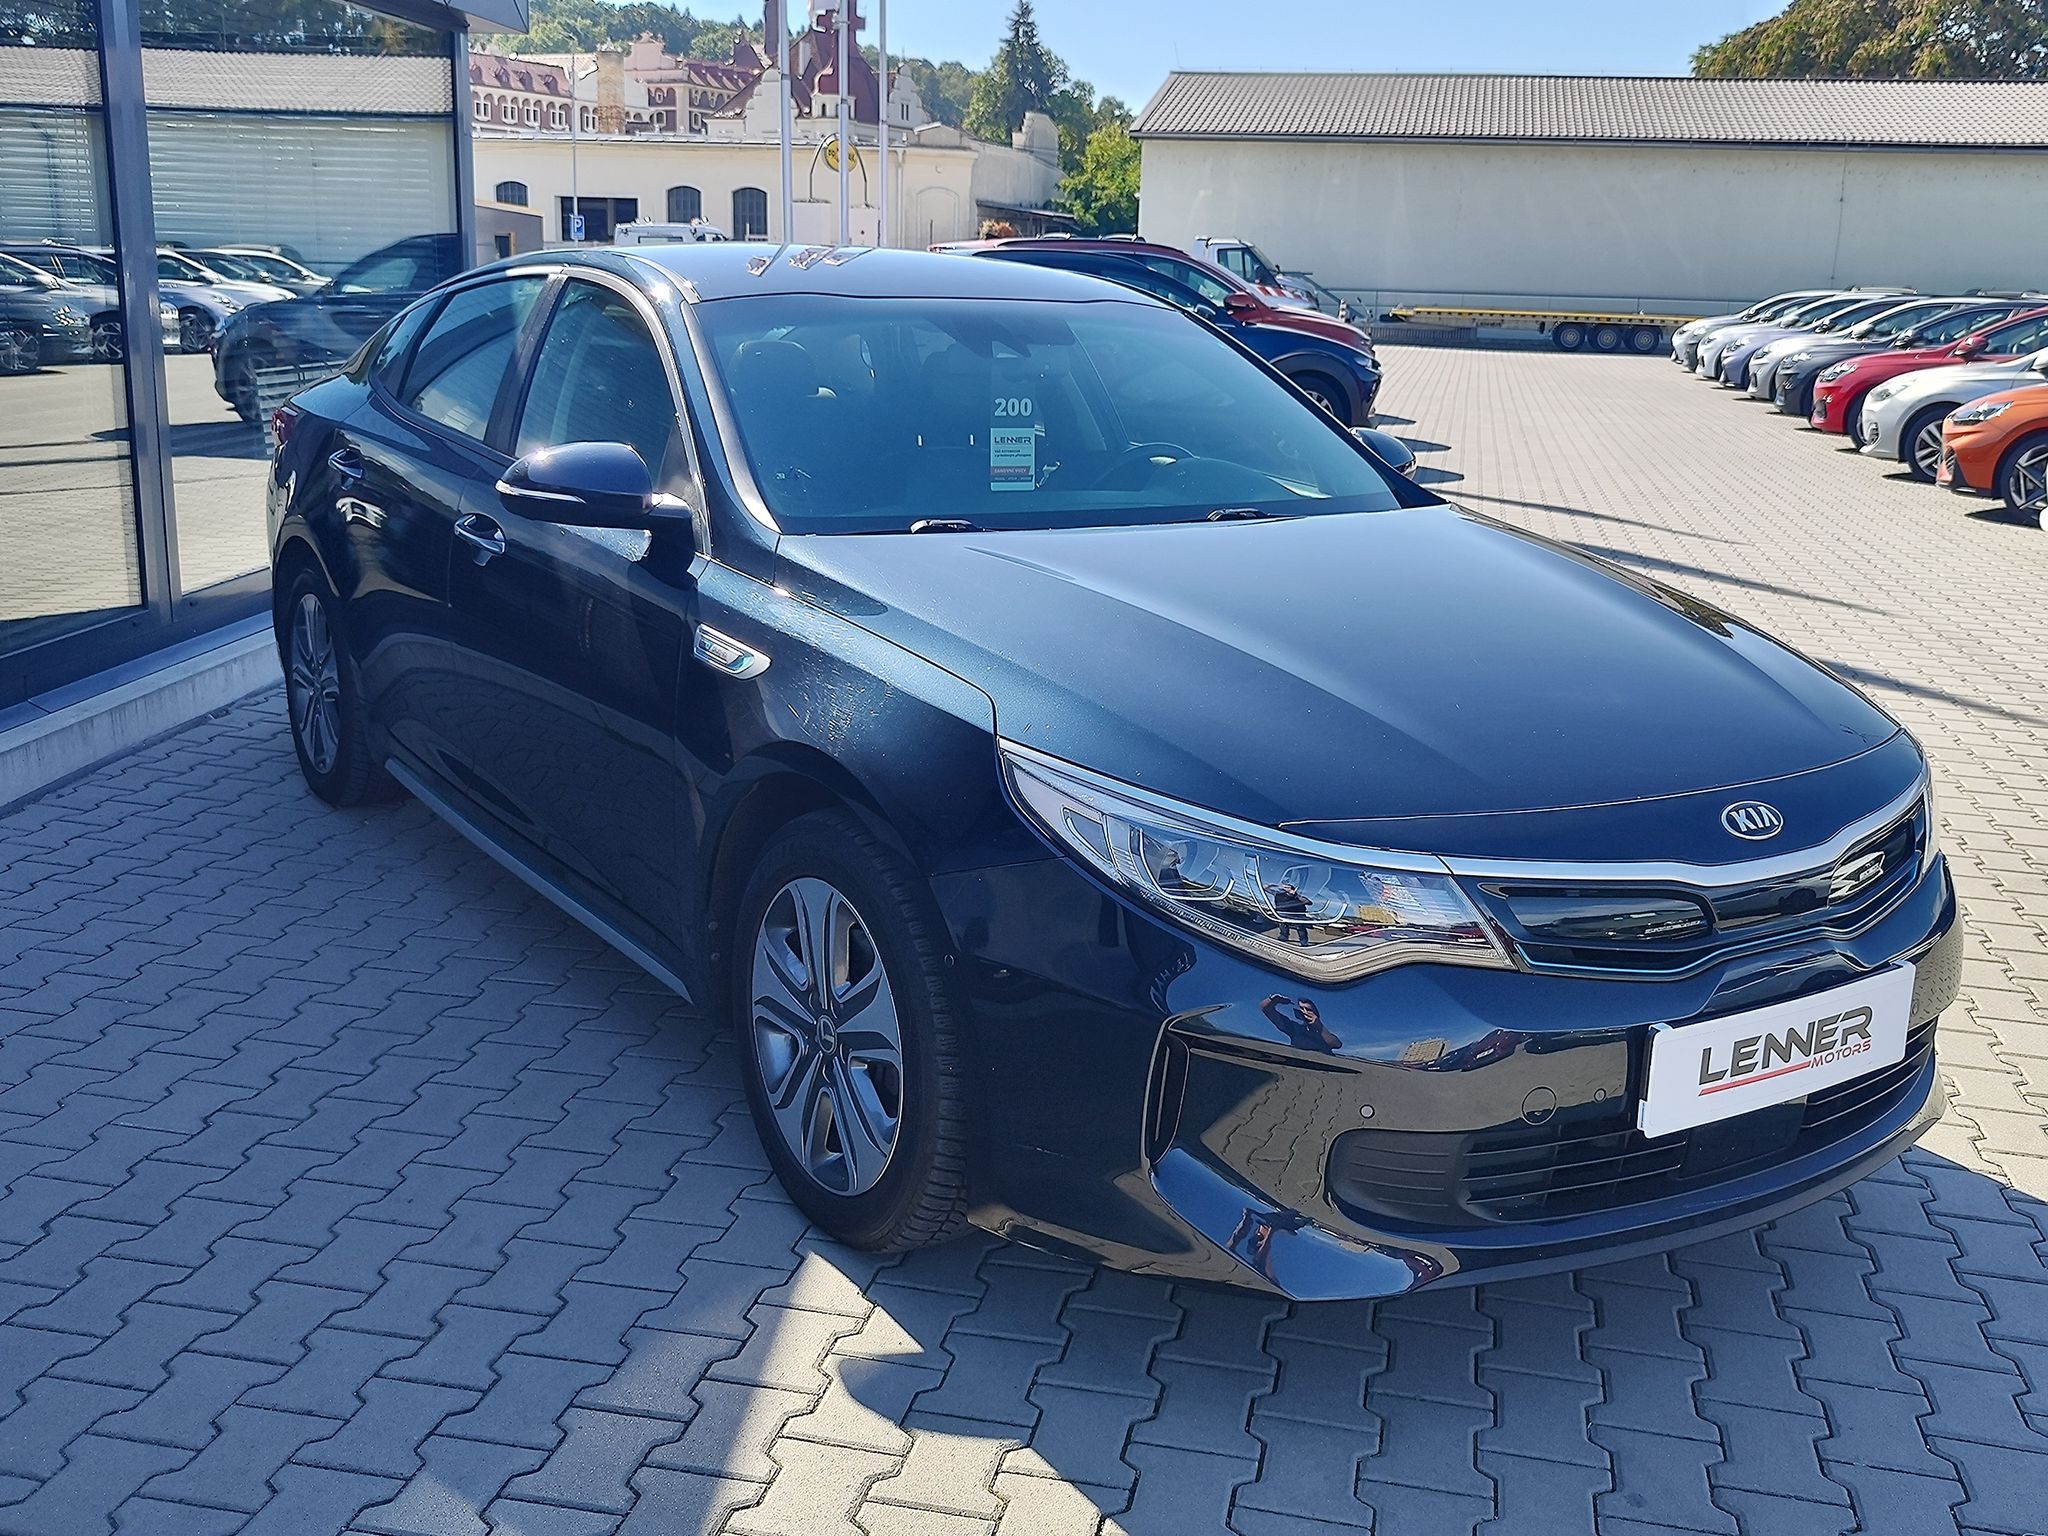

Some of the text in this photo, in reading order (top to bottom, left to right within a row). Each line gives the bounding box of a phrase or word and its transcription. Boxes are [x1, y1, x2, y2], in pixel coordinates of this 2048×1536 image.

[574, 219, 582, 232] P
[994, 397, 1033, 417] 200
[994, 436, 1032, 445] LENNER
[1729, 806, 1779, 833] KIA
[1698, 1005, 1873, 1085] LENNER
[1810, 1040, 1872, 1069] MOTORS
